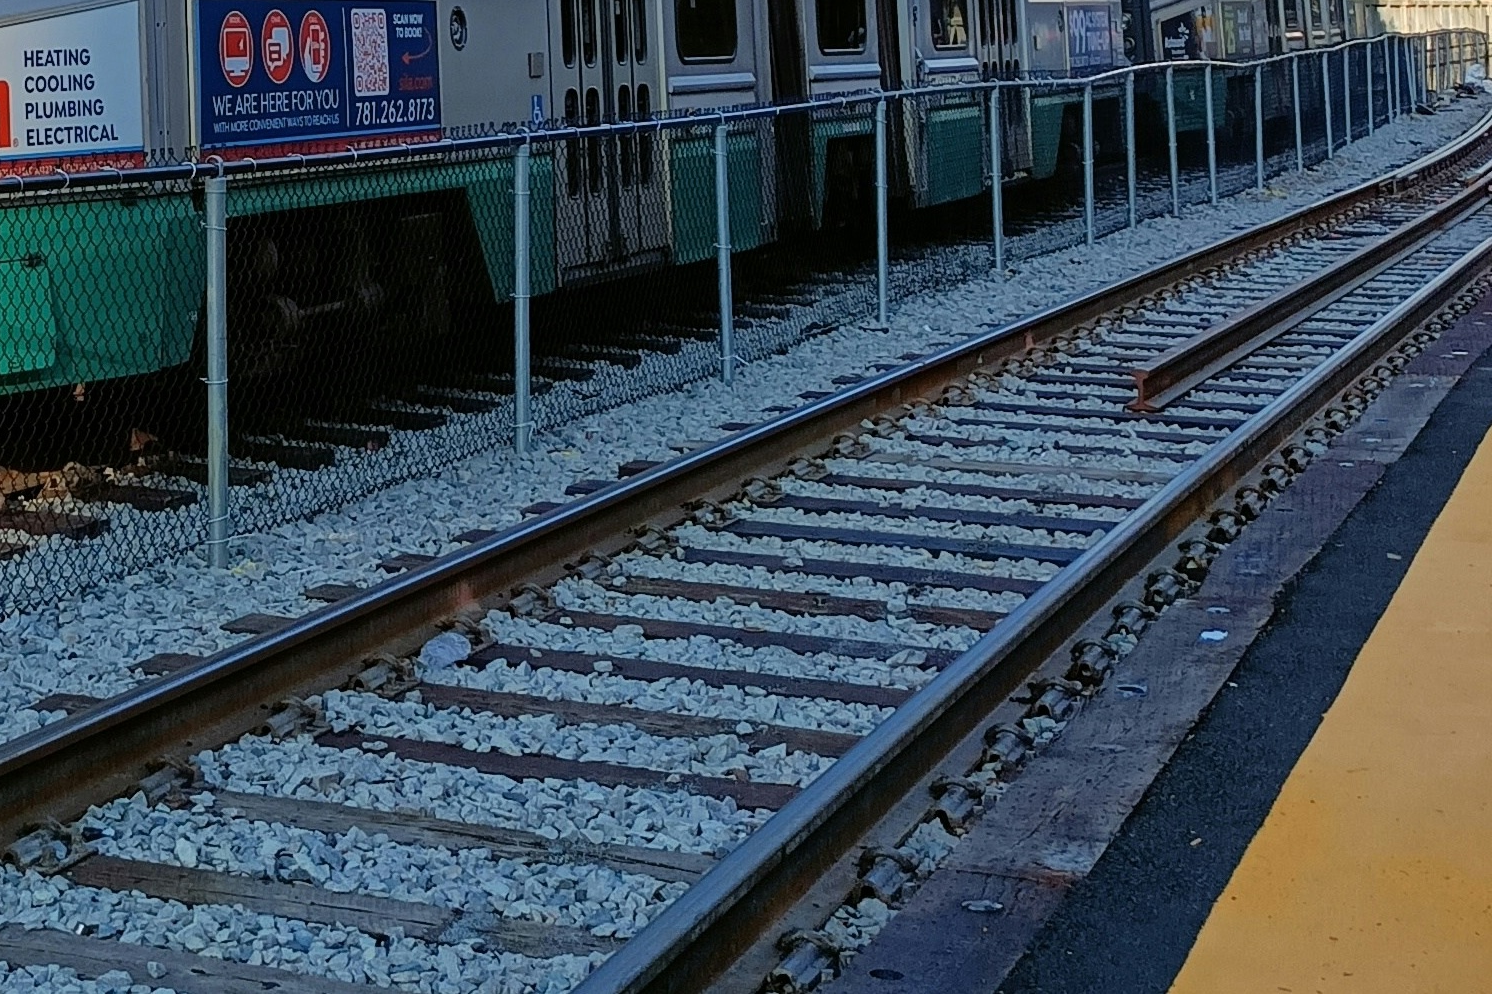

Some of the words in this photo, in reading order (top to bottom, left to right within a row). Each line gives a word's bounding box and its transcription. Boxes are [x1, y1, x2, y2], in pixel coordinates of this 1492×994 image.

[392, 13, 408, 25] SCAN
[408, 13, 424, 25] NOW
[395, 27, 404, 39] TO
[23, 48, 91, 67] HEATING
[24, 73, 96, 94] COOLING
[25, 99, 105, 119] PLUMBING
[212, 95, 233, 117] WE
[234, 93, 259, 115] ARE
[260, 91, 290, 114] HERE
[291, 90, 314, 111] FOR
[314, 88, 340, 110] YOU
[355, 97, 435, 126] 781.262.8173
[26, 123, 119, 146] ELECTRICAL
[213, 121, 229, 133] WITH
[230, 119, 249, 132] MORE
